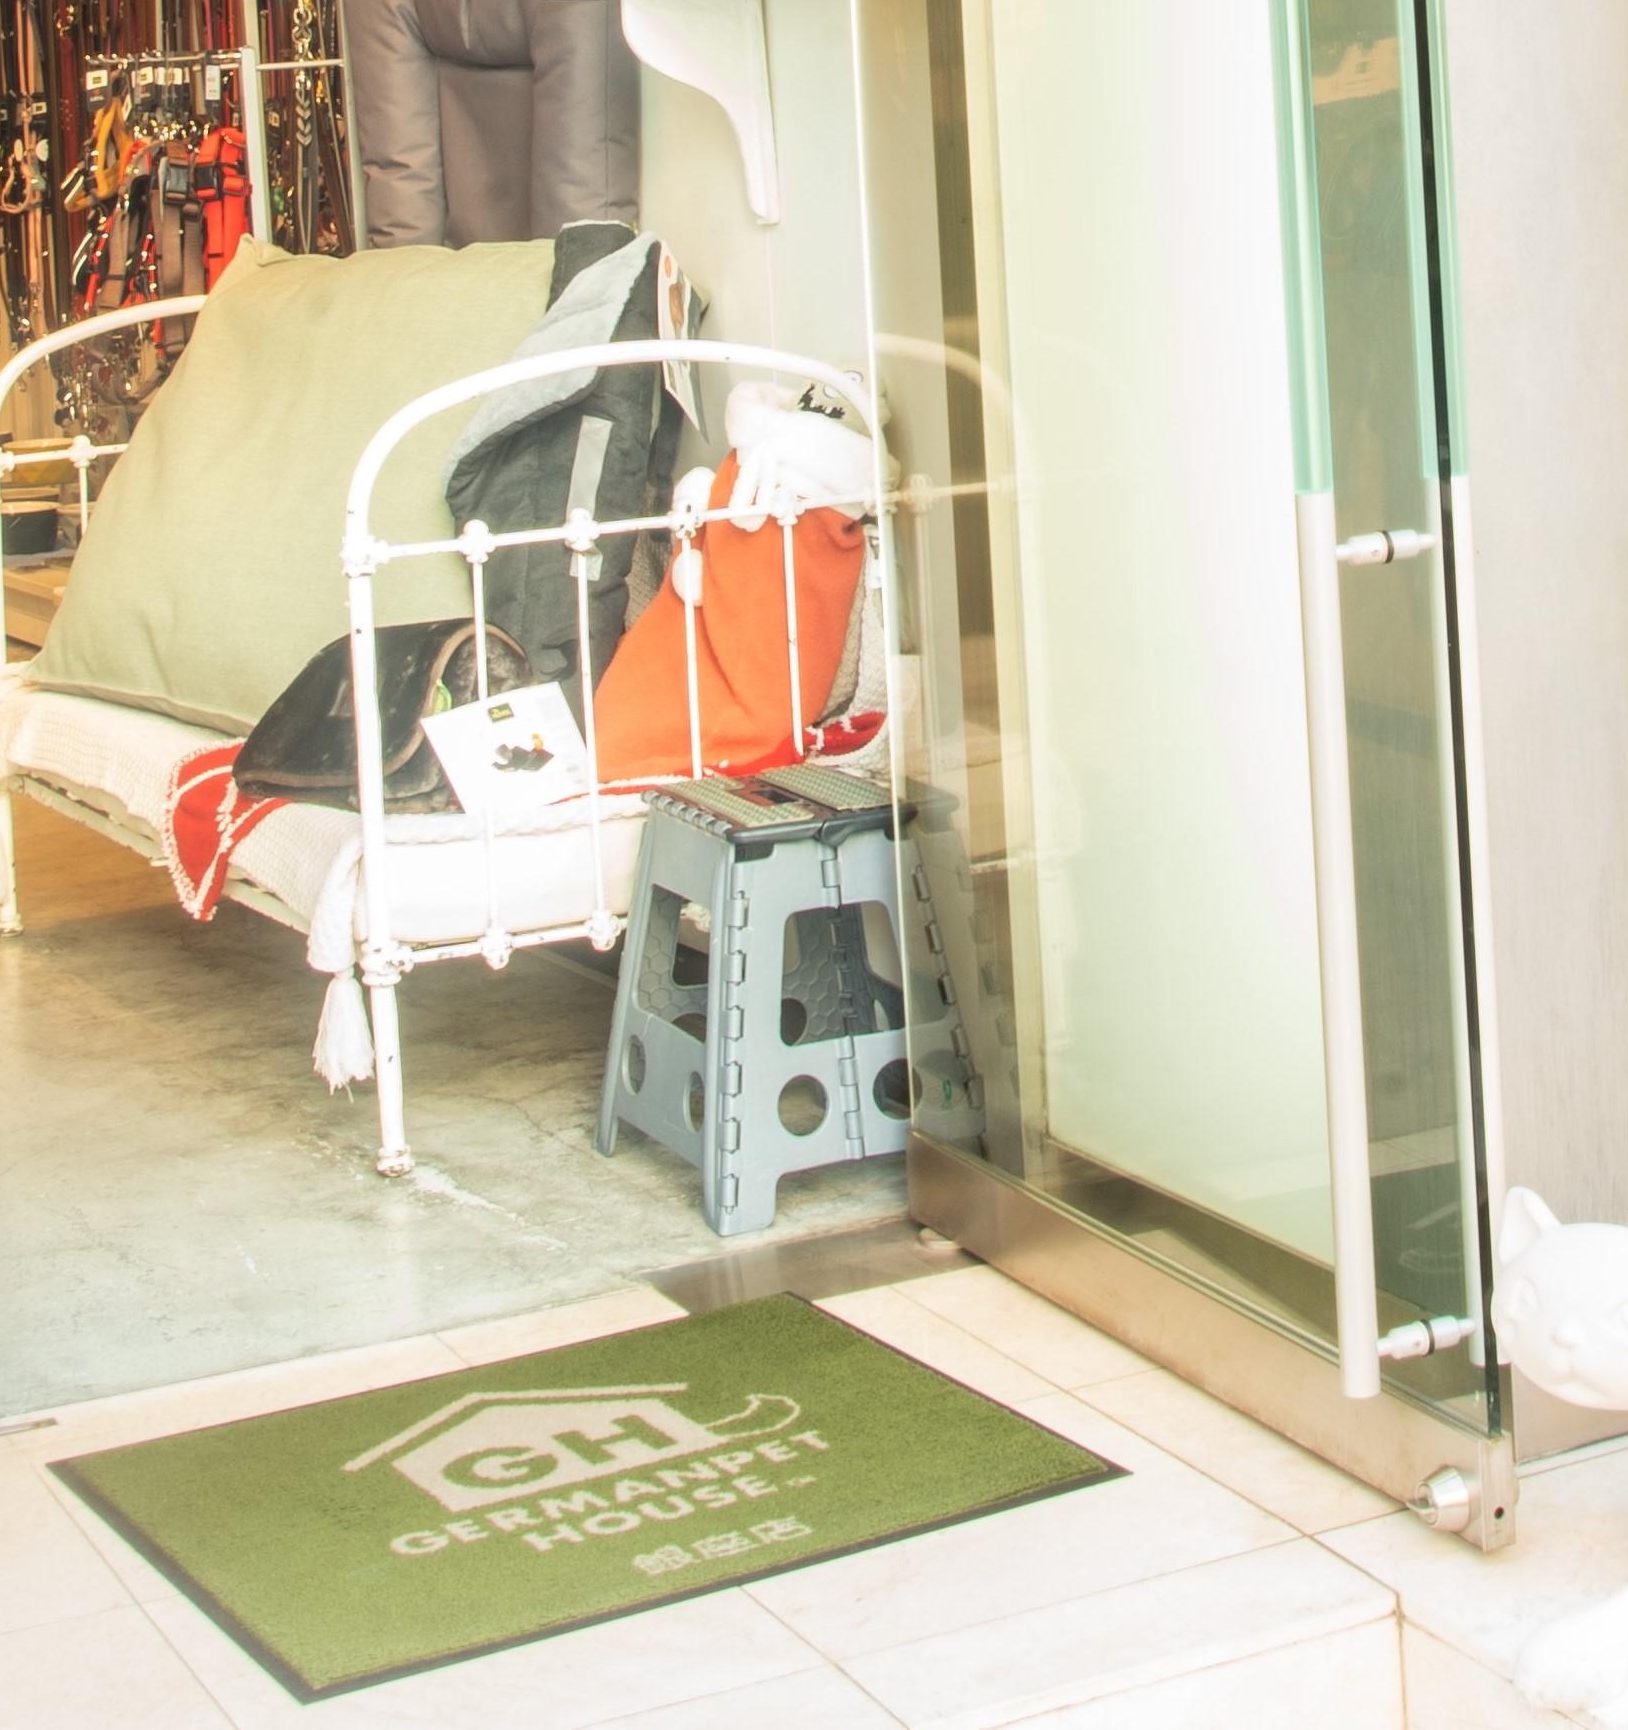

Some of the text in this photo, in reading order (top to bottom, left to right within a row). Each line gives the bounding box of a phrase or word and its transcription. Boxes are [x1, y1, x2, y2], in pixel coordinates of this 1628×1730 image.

[441, 1414, 678, 1489] GH
[389, 1429, 829, 1556] GERMANPET
[523, 1473, 778, 1552] HOUSE
